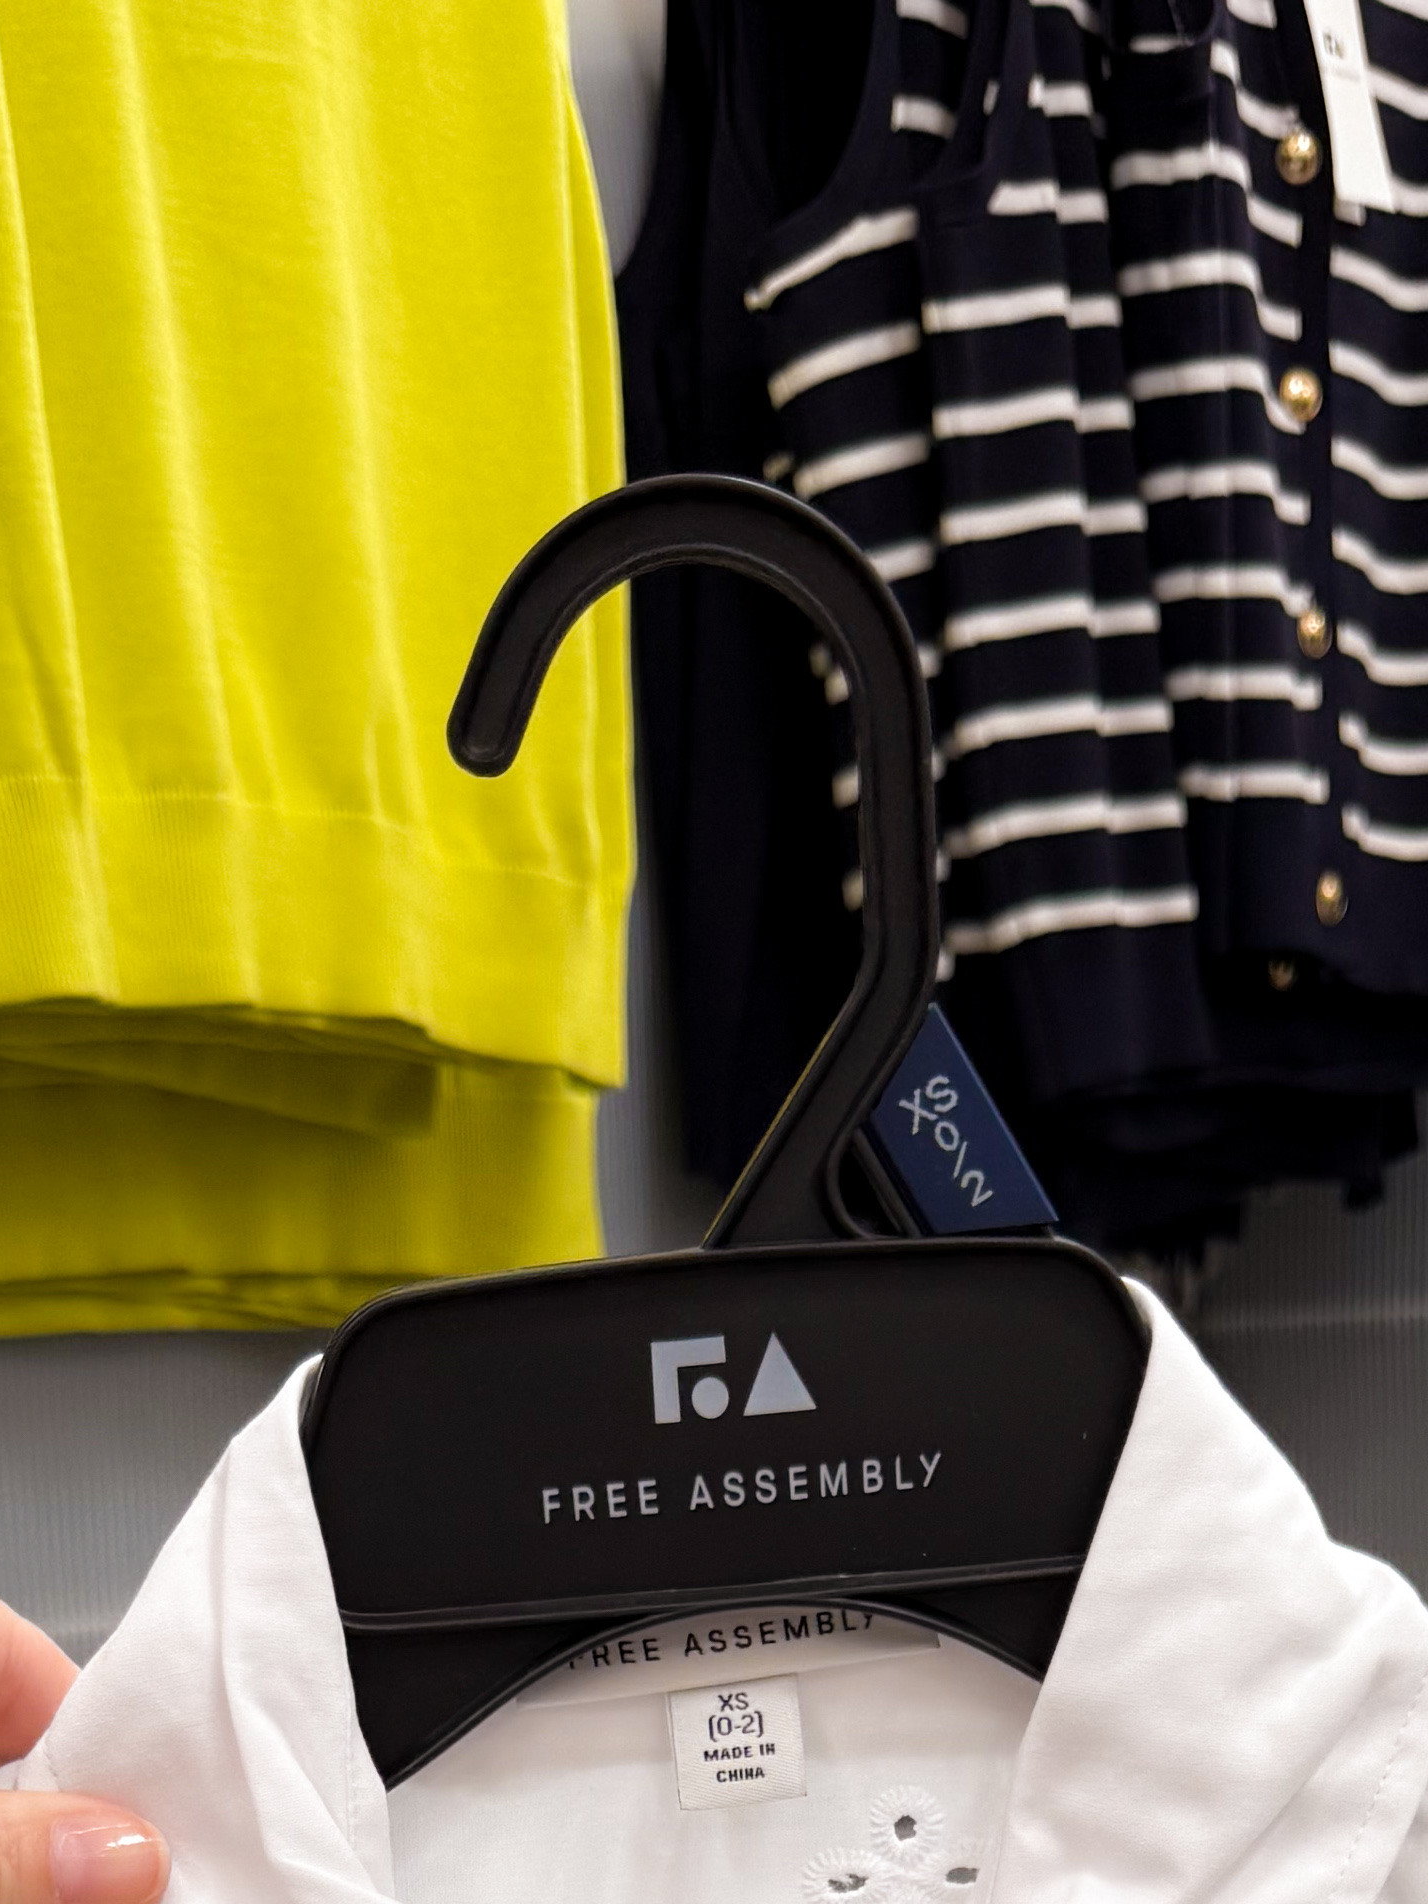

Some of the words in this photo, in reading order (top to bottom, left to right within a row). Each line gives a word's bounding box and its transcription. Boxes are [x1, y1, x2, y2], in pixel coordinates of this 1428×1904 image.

[899, 1074, 959, 1136] XS
[542, 1479, 661, 1524] FREE
[690, 1452, 942, 1510] ASSEMBLY
[718, 1692, 749, 1711] XS
[708, 1710, 764, 1742] (0-2)
[704, 1745, 752, 1762] MADE
[760, 1742, 776, 1756] IN
[717, 1766, 765, 1783] CHINA
